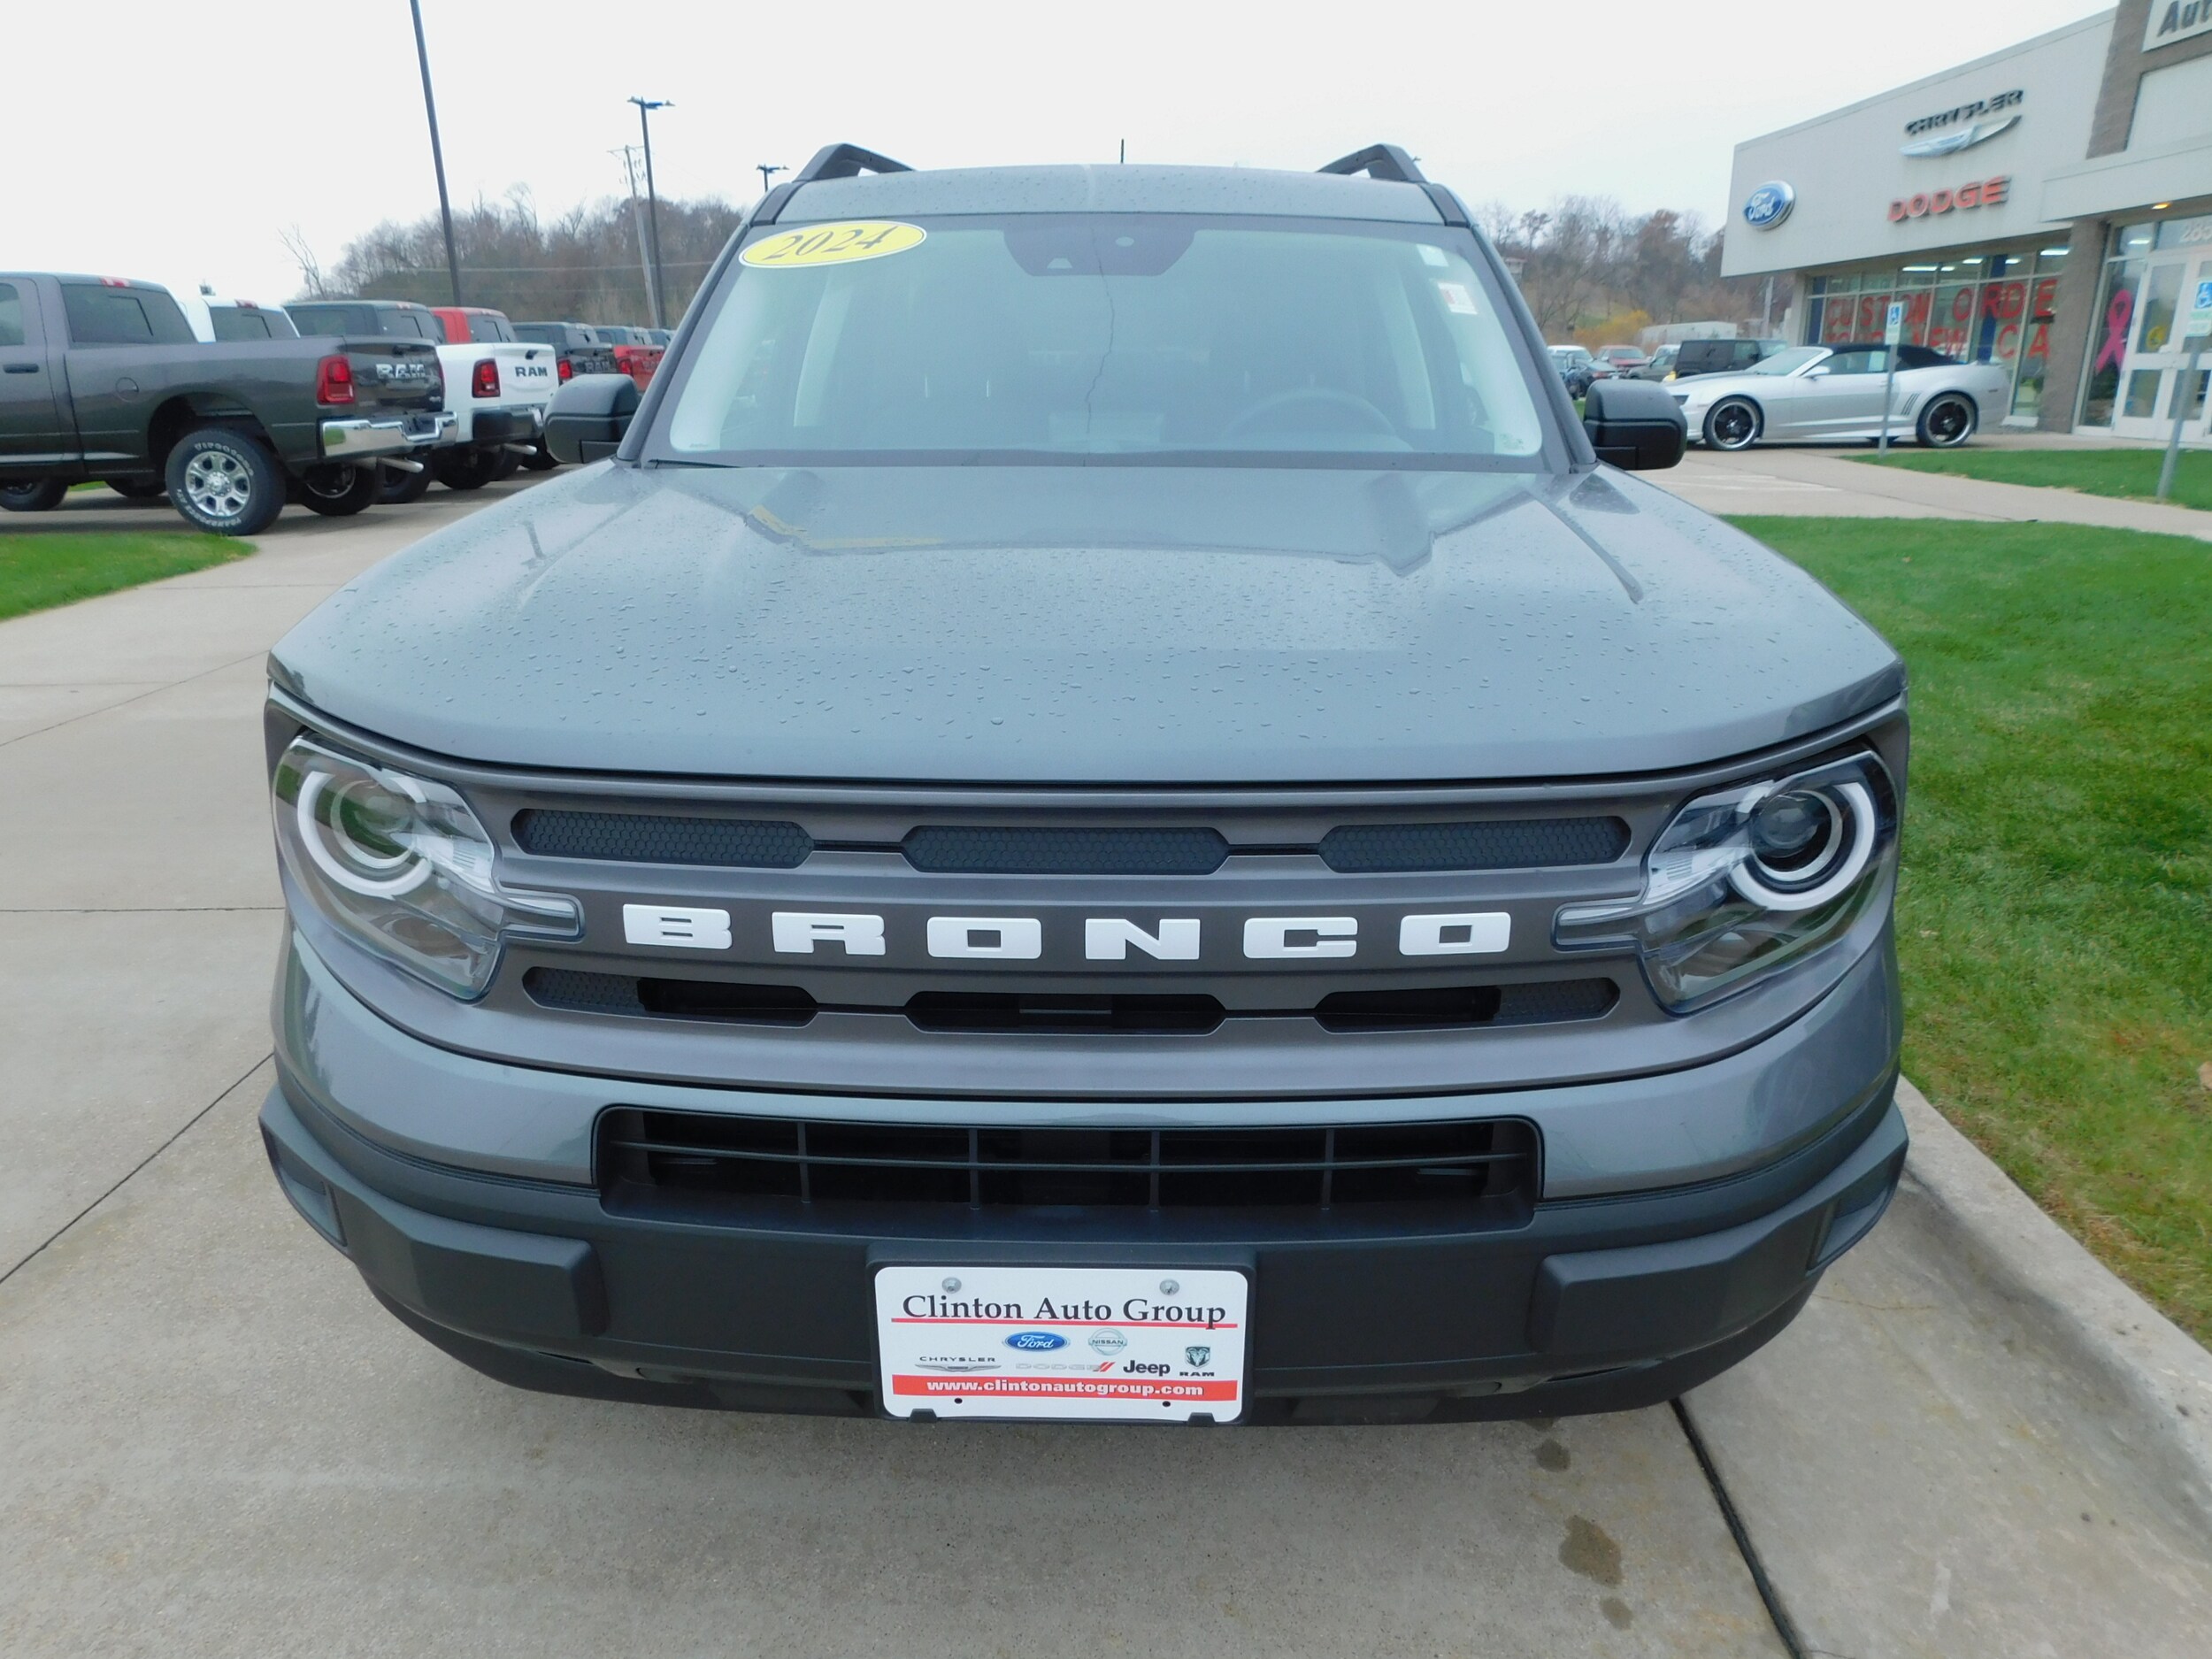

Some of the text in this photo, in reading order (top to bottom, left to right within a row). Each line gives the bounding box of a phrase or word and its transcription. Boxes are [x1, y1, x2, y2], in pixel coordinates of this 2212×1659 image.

[1904, 89, 2024, 134] CHRYSLER
[1887, 176, 2010, 222] DODGE
[762, 226, 898, 261] 2024
[376, 364, 426, 379] RAM
[515, 366, 548, 377] RAM
[623, 903, 1511, 960] BRONCO
[902, 1294, 1226, 1330] Clinton Auto Group
[1018, 1335, 1055, 1348] Ford
[1015, 1363, 1102, 1372] DODGE
[1123, 1360, 1171, 1377] Jeep
[926, 1379, 1204, 1397] www.clintonautogroup.com
